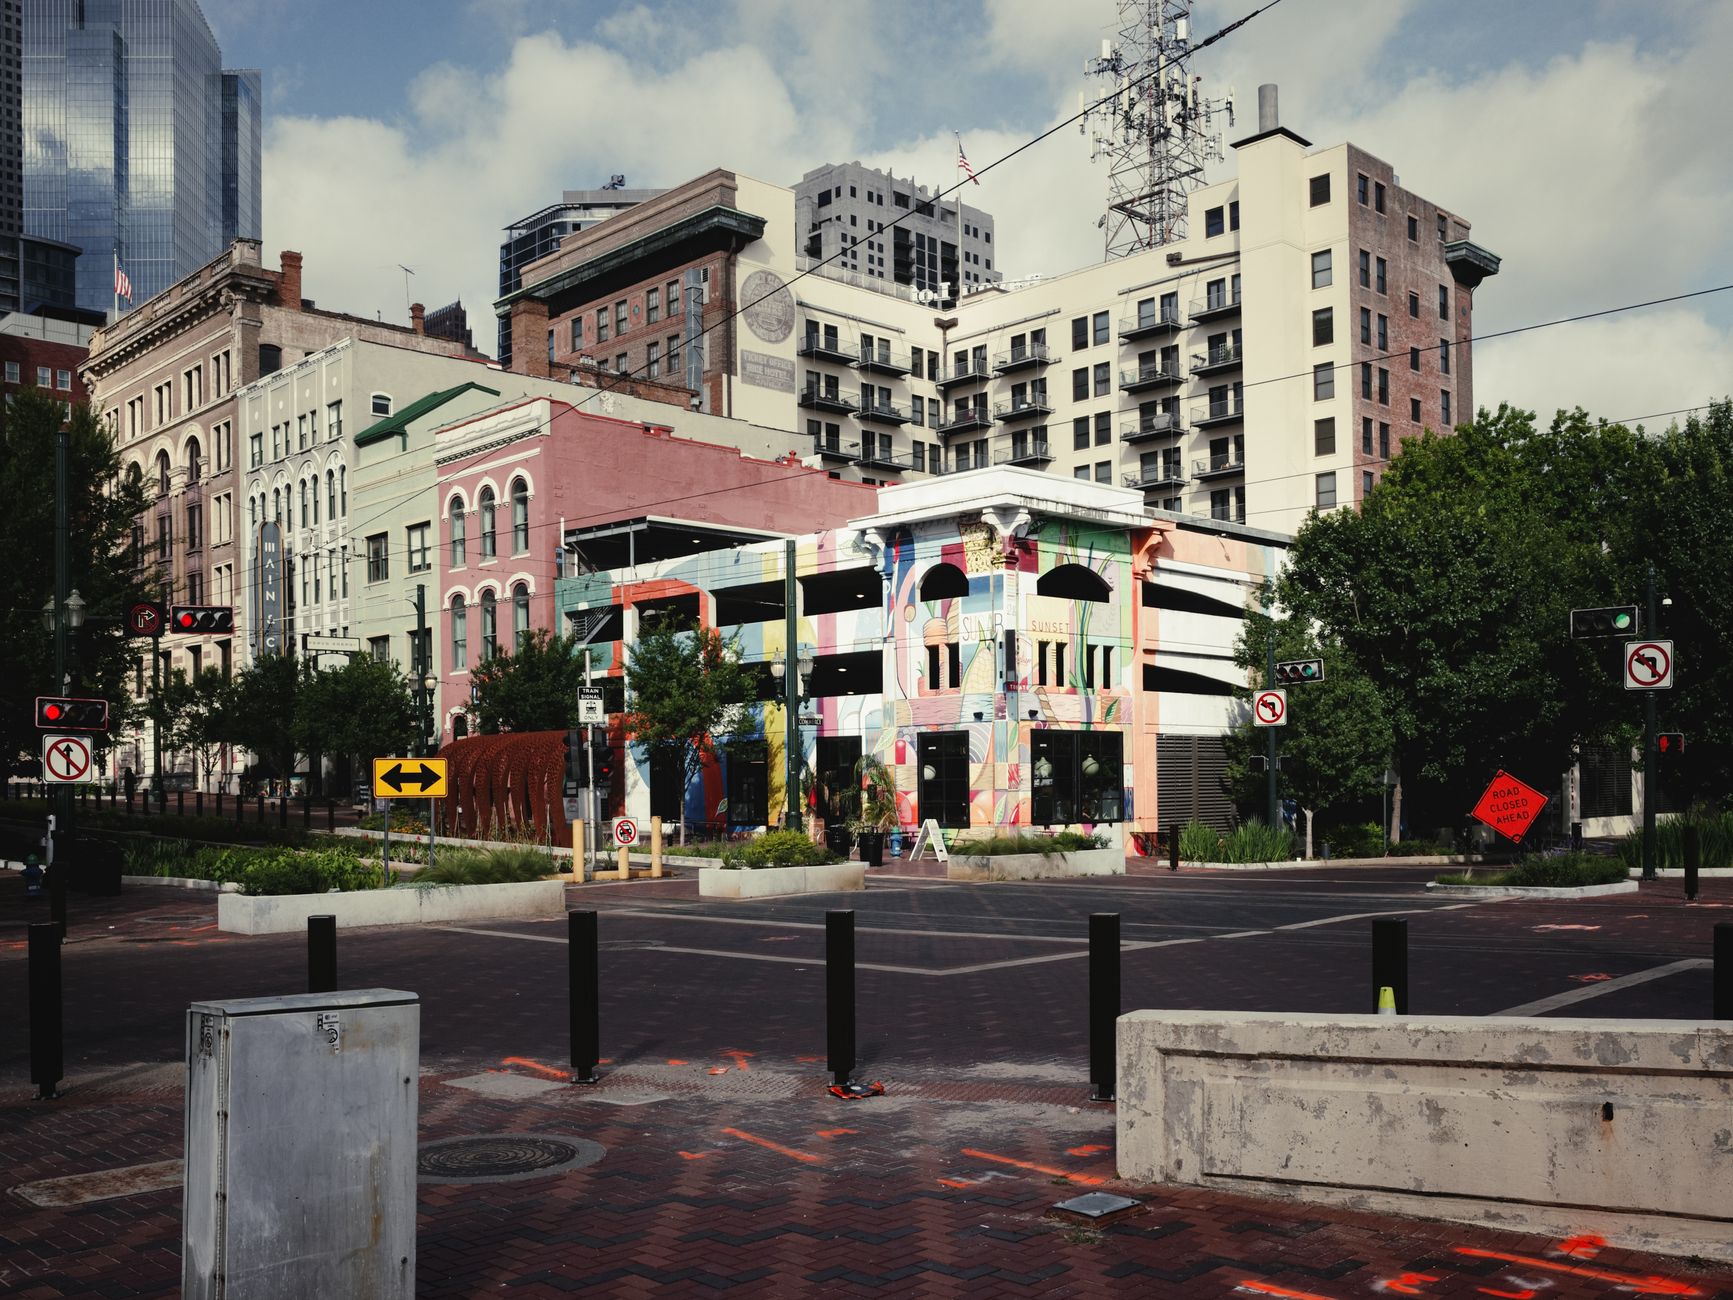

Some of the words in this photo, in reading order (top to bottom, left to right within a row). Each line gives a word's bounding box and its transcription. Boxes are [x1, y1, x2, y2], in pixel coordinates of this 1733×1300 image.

[264, 542, 276, 602] MAIN
[1031, 620, 1069, 633] SUNSET
[1492, 786, 1520, 800] ROAD
[1489, 798, 1528, 813] CLOSED
[1496, 811, 1530, 825] AHEAD
